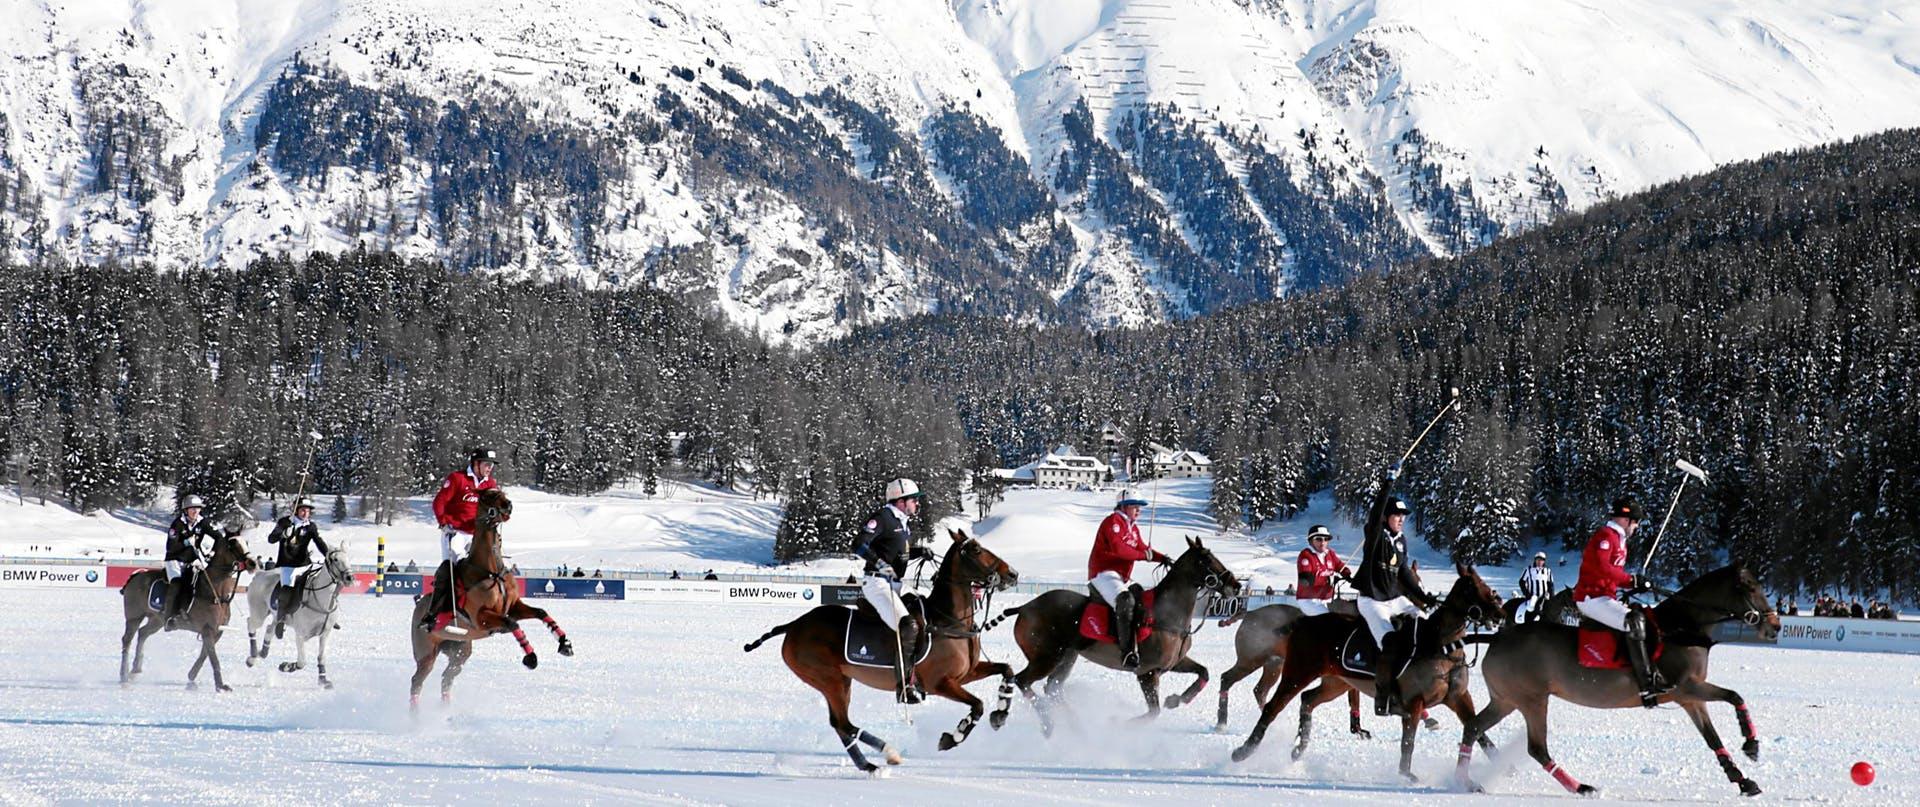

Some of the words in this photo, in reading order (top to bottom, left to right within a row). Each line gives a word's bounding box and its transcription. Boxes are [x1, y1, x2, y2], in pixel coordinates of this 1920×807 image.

[3, 570, 37, 581] BMW
[40, 570, 80, 582] Power
[729, 587, 760, 598] BMW
[762, 587, 798, 600] Power
[1782, 624, 1806, 638] BMW
[1806, 625, 1833, 640] Power
